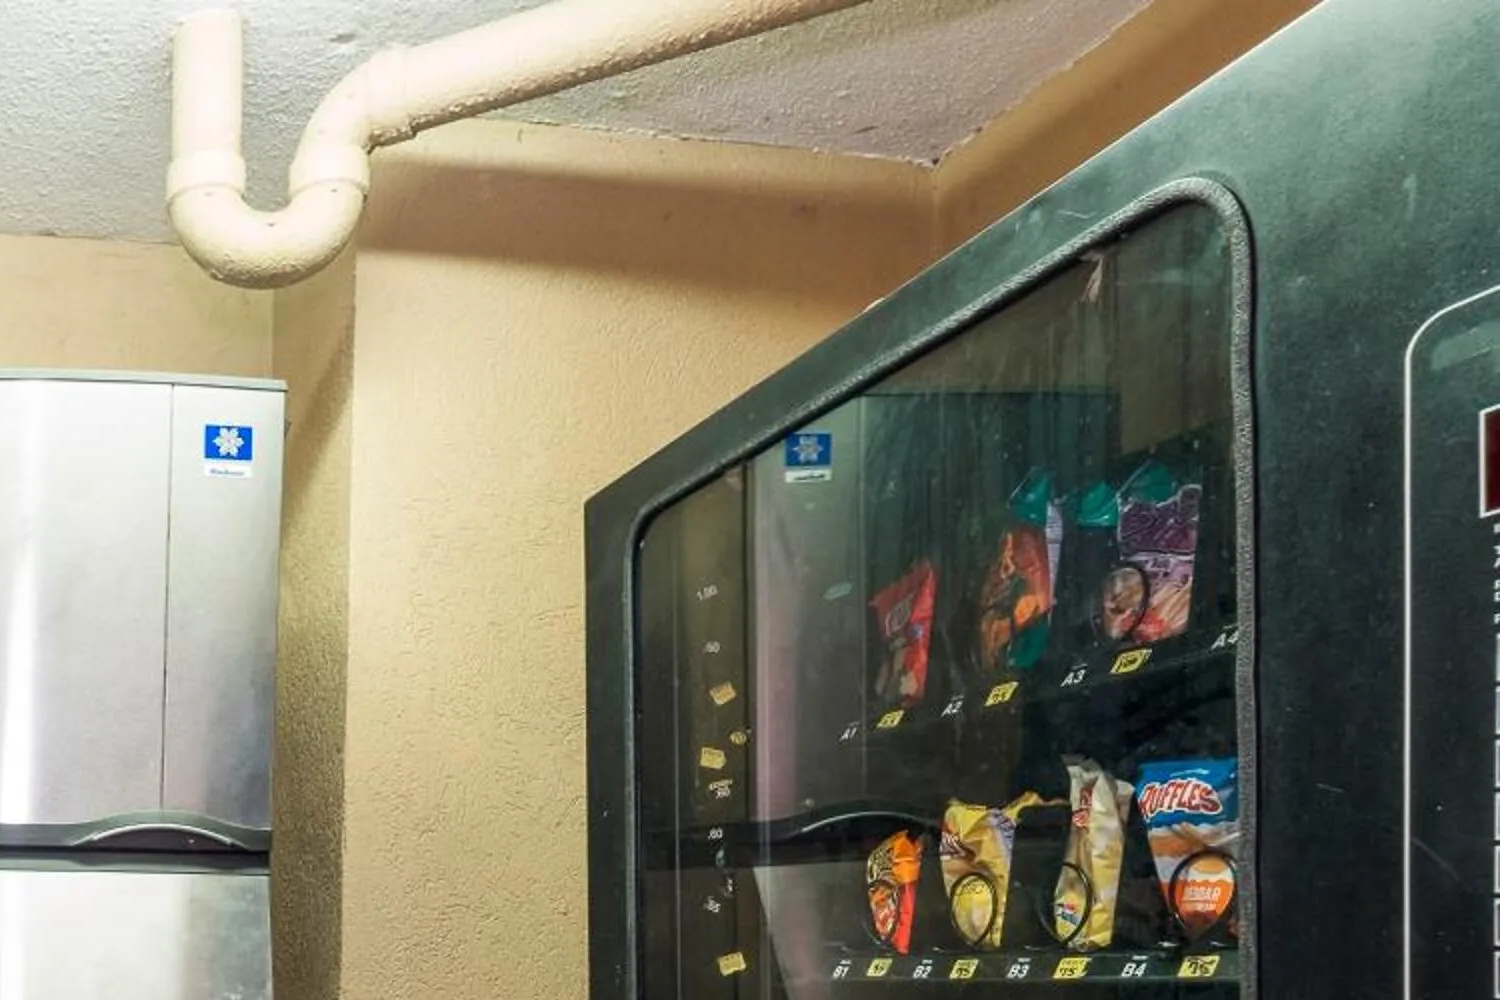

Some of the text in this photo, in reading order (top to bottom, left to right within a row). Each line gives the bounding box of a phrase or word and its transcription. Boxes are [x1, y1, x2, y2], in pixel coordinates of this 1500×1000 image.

[1060, 669, 1087, 687] A3
[941, 700, 963, 717] A2
[1137, 777, 1223, 822] RUFFLES
[832, 966, 850, 979] B1
[913, 965, 932, 979] B2
[1007, 964, 1031, 979] B3
[1121, 962, 1147, 978] B4
